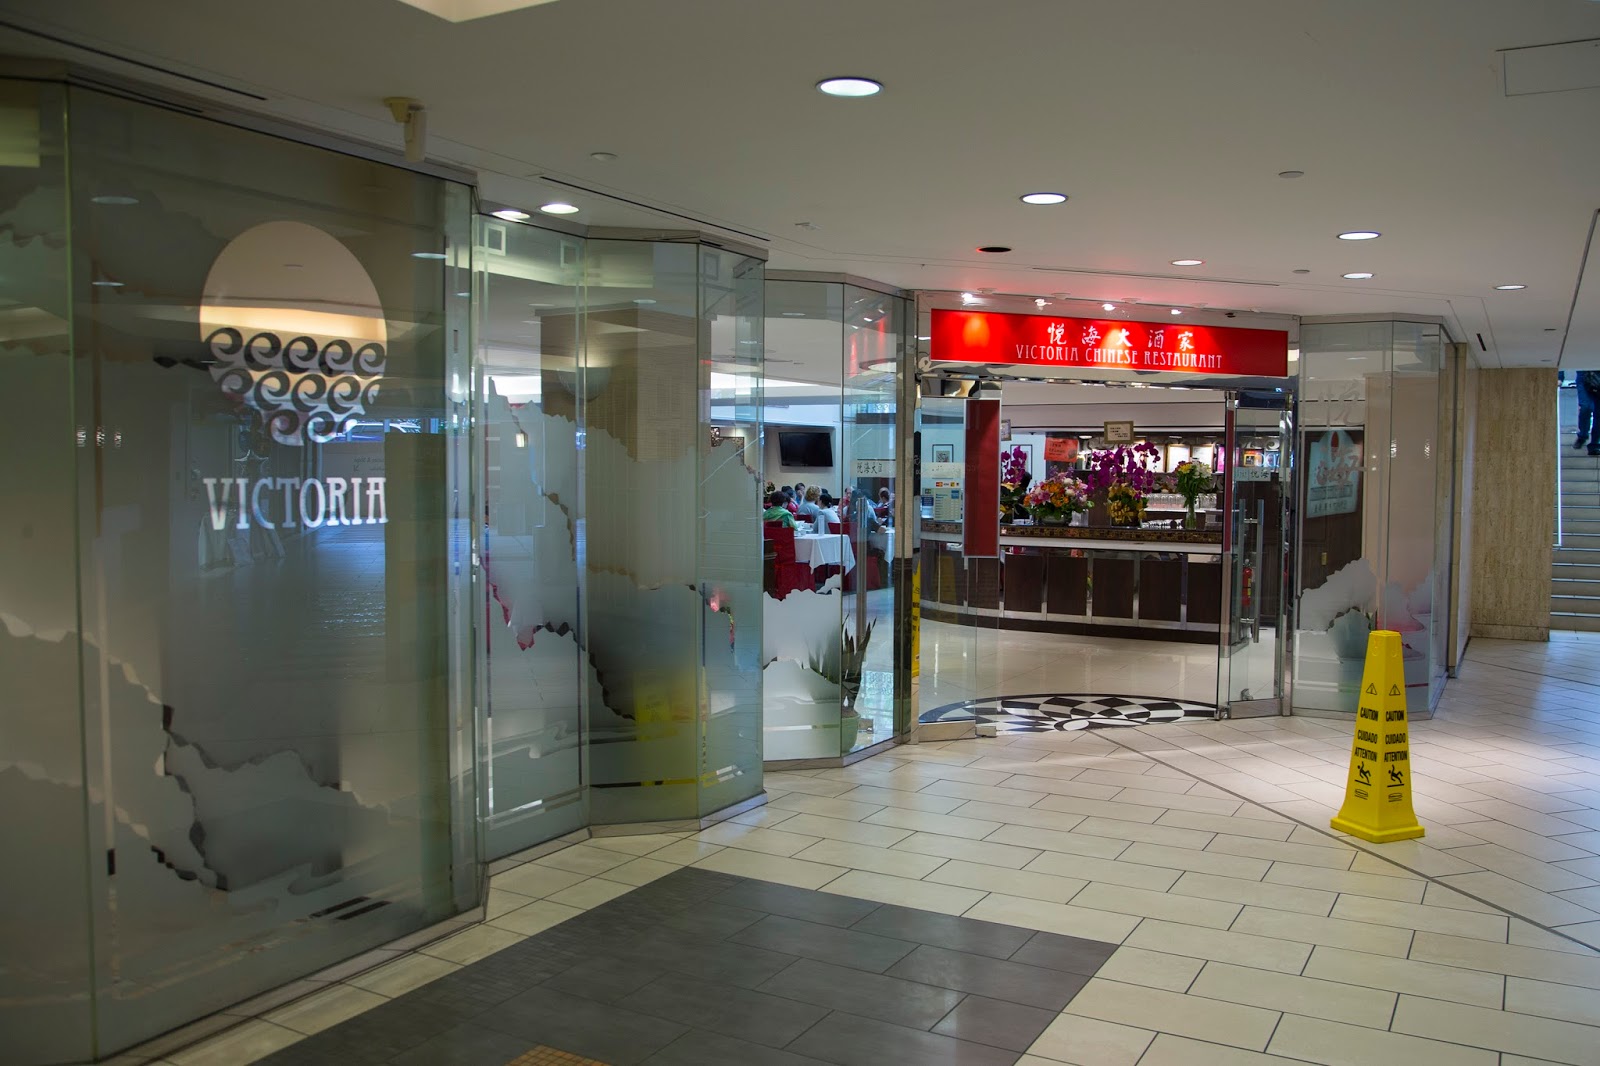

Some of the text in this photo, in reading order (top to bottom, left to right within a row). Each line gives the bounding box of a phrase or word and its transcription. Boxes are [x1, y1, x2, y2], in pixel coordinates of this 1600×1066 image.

[1015, 344, 1223, 368] VICTORIA CHINESE RESTAURANT
[203, 477, 389, 530] VICTORIA
[1360, 707, 1378, 722] CAUTION
[1386, 710, 1404, 722] CAUTION
[1358, 729, 1378, 744] CUIDADO
[1385, 733, 1406, 745] CUIDADO
[1355, 747, 1378, 763] ATTENTION
[1384, 751, 1408, 763] ATTENTION
